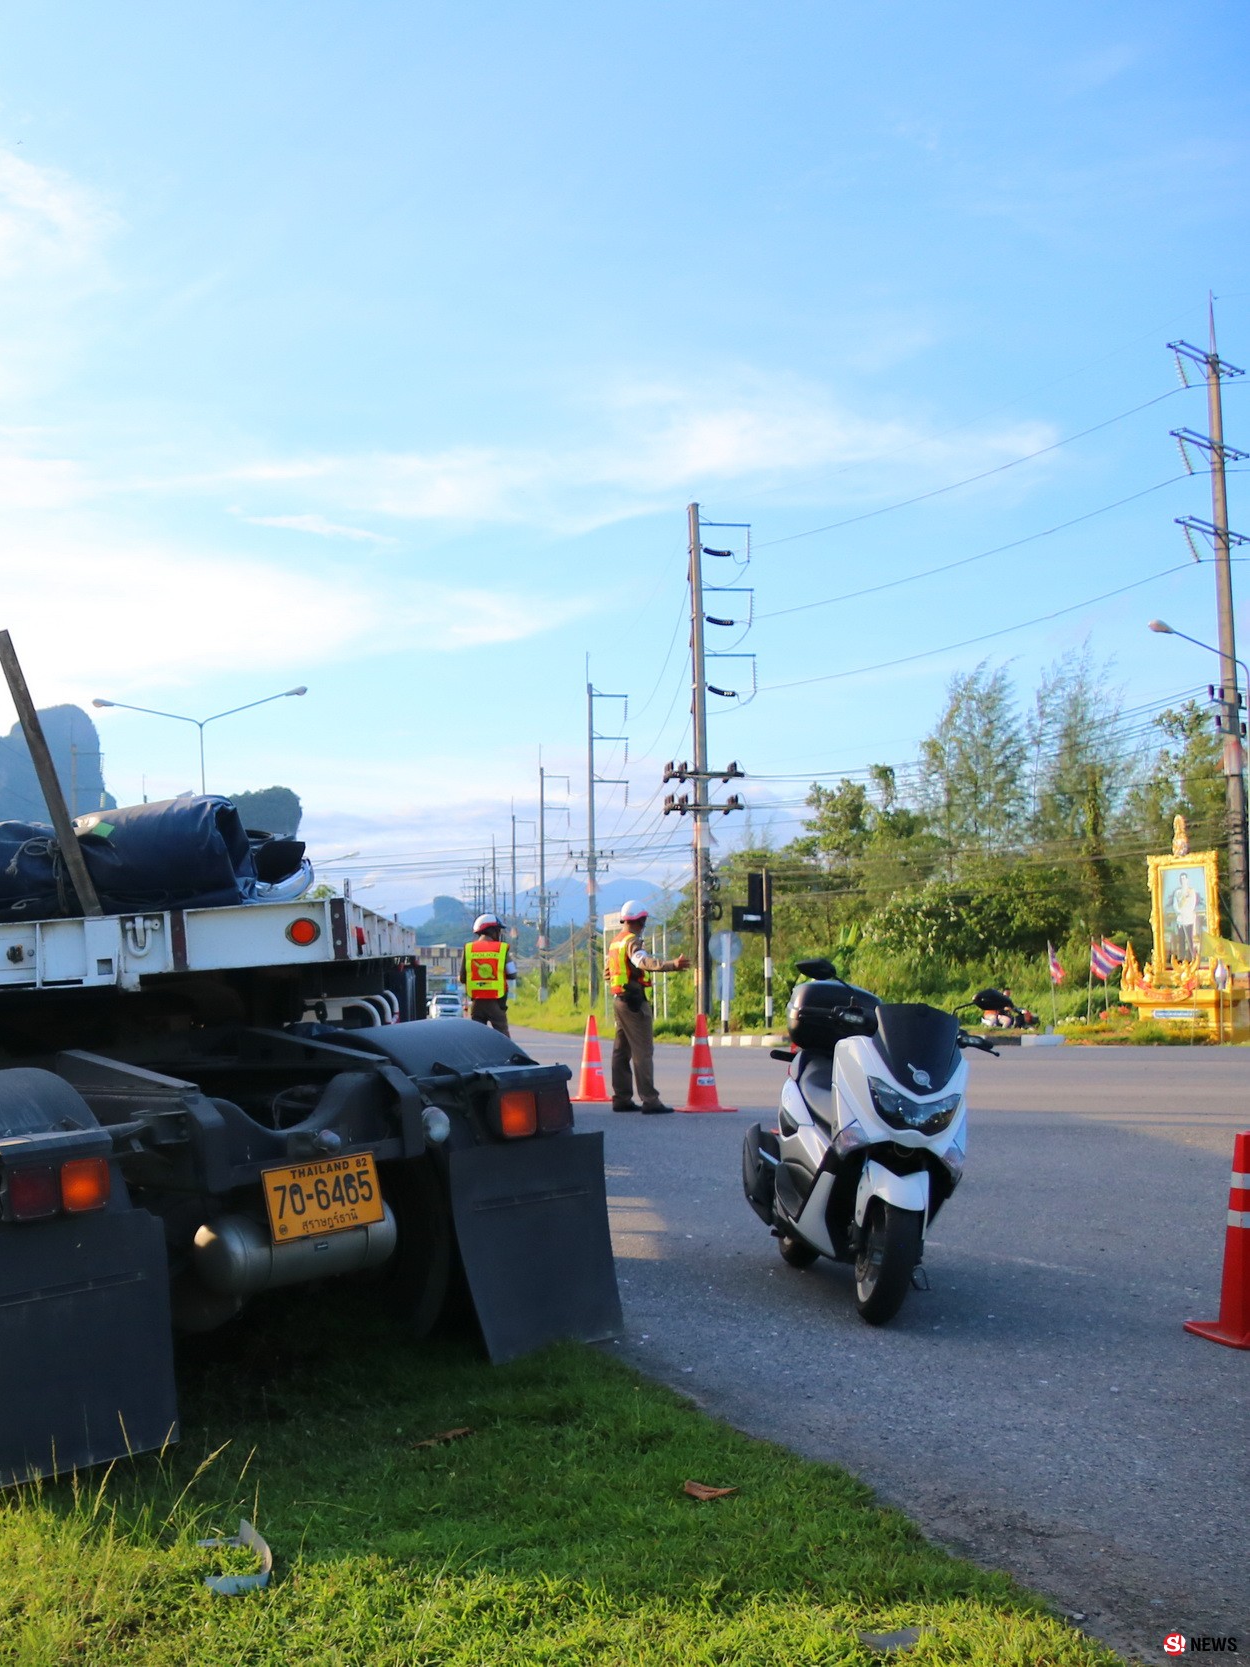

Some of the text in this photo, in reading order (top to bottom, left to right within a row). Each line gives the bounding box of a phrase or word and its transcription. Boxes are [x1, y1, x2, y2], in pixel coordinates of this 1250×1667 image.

[290, 1157, 368, 1180] THAILAND 82
[273, 1169, 373, 1220] 70-6465
